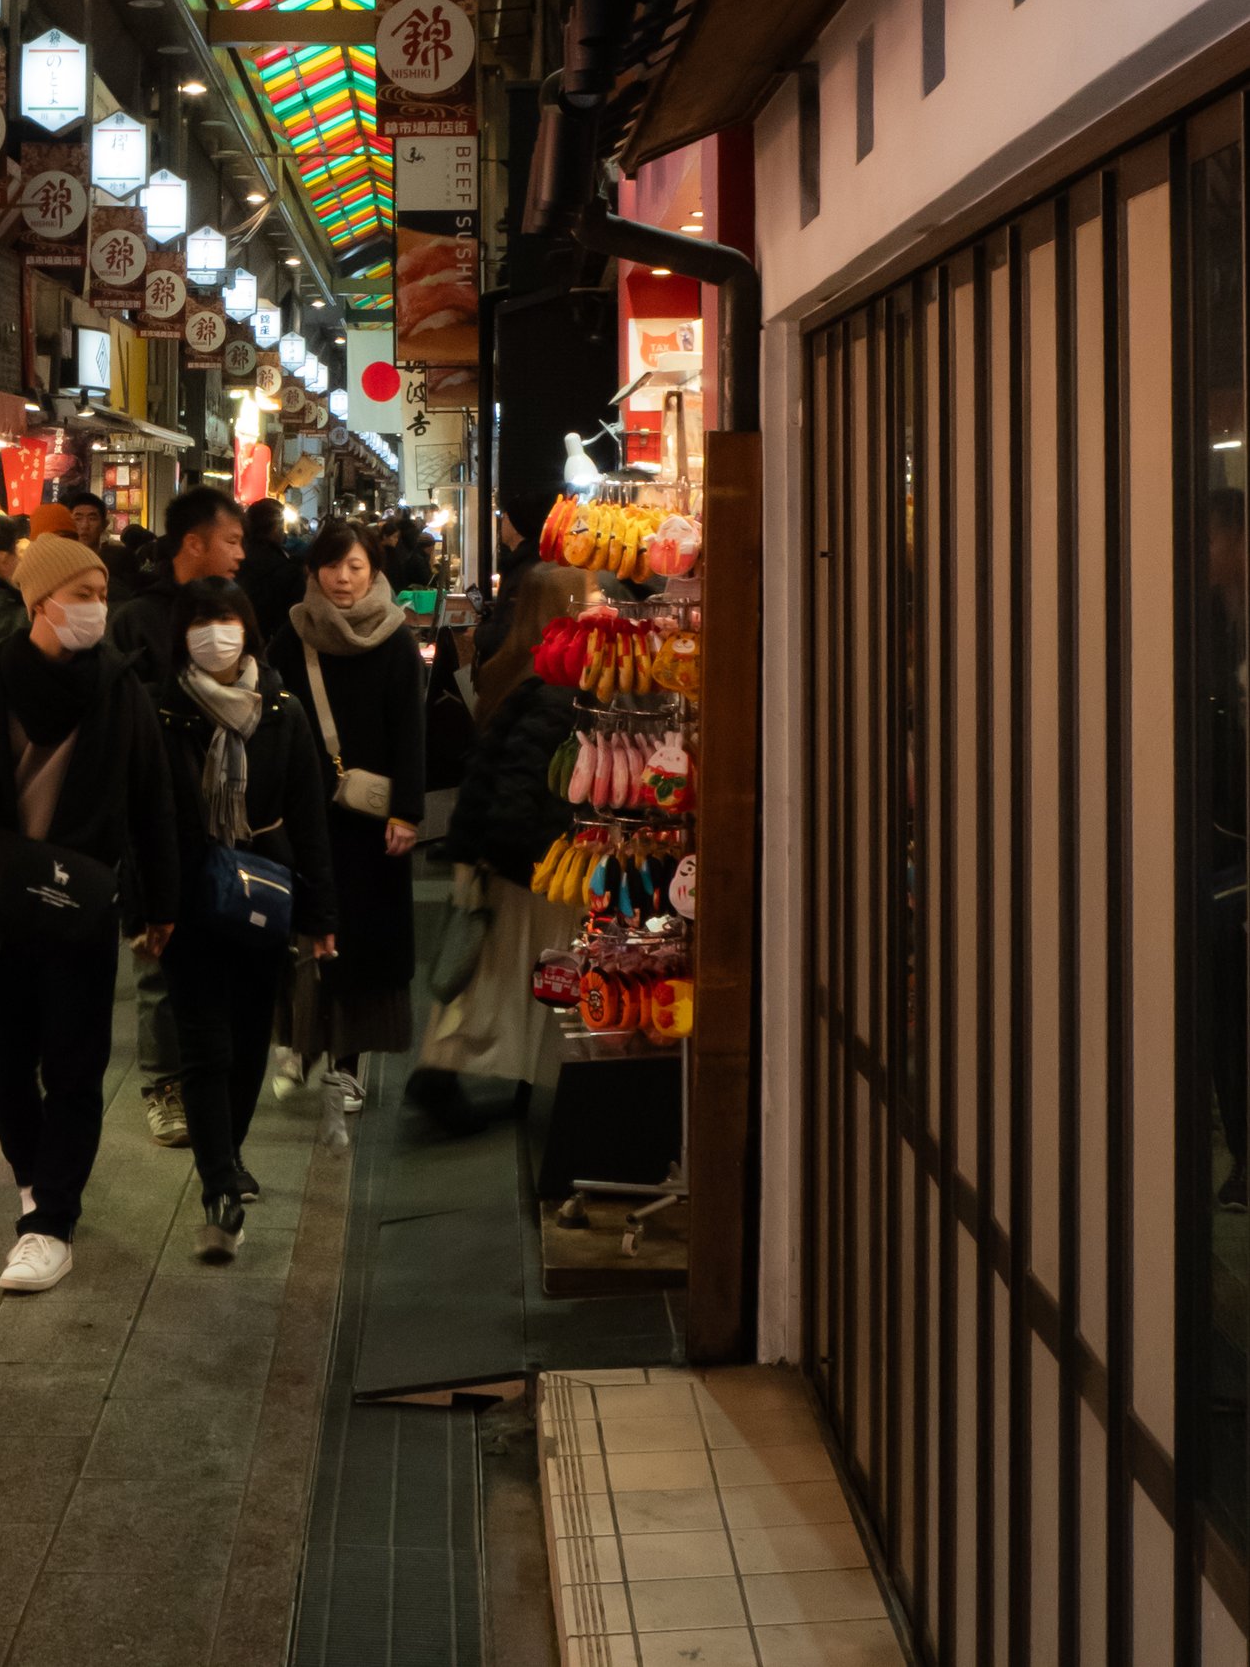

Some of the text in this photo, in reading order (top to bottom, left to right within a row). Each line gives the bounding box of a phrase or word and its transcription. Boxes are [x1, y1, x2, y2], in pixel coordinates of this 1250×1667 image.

[391, 5, 454, 82] 錦
[391, 68, 431, 79] NISHIKI
[384, 120, 468, 135] 錦市場商店街
[455, 146, 472, 204] BEEF
[31, 179, 73, 229] 錦
[100, 236, 134, 279] 錦
[455, 215, 473, 287] SUSHI
[147, 276, 176, 313] 錦
[192, 317, 217, 346] 錦
